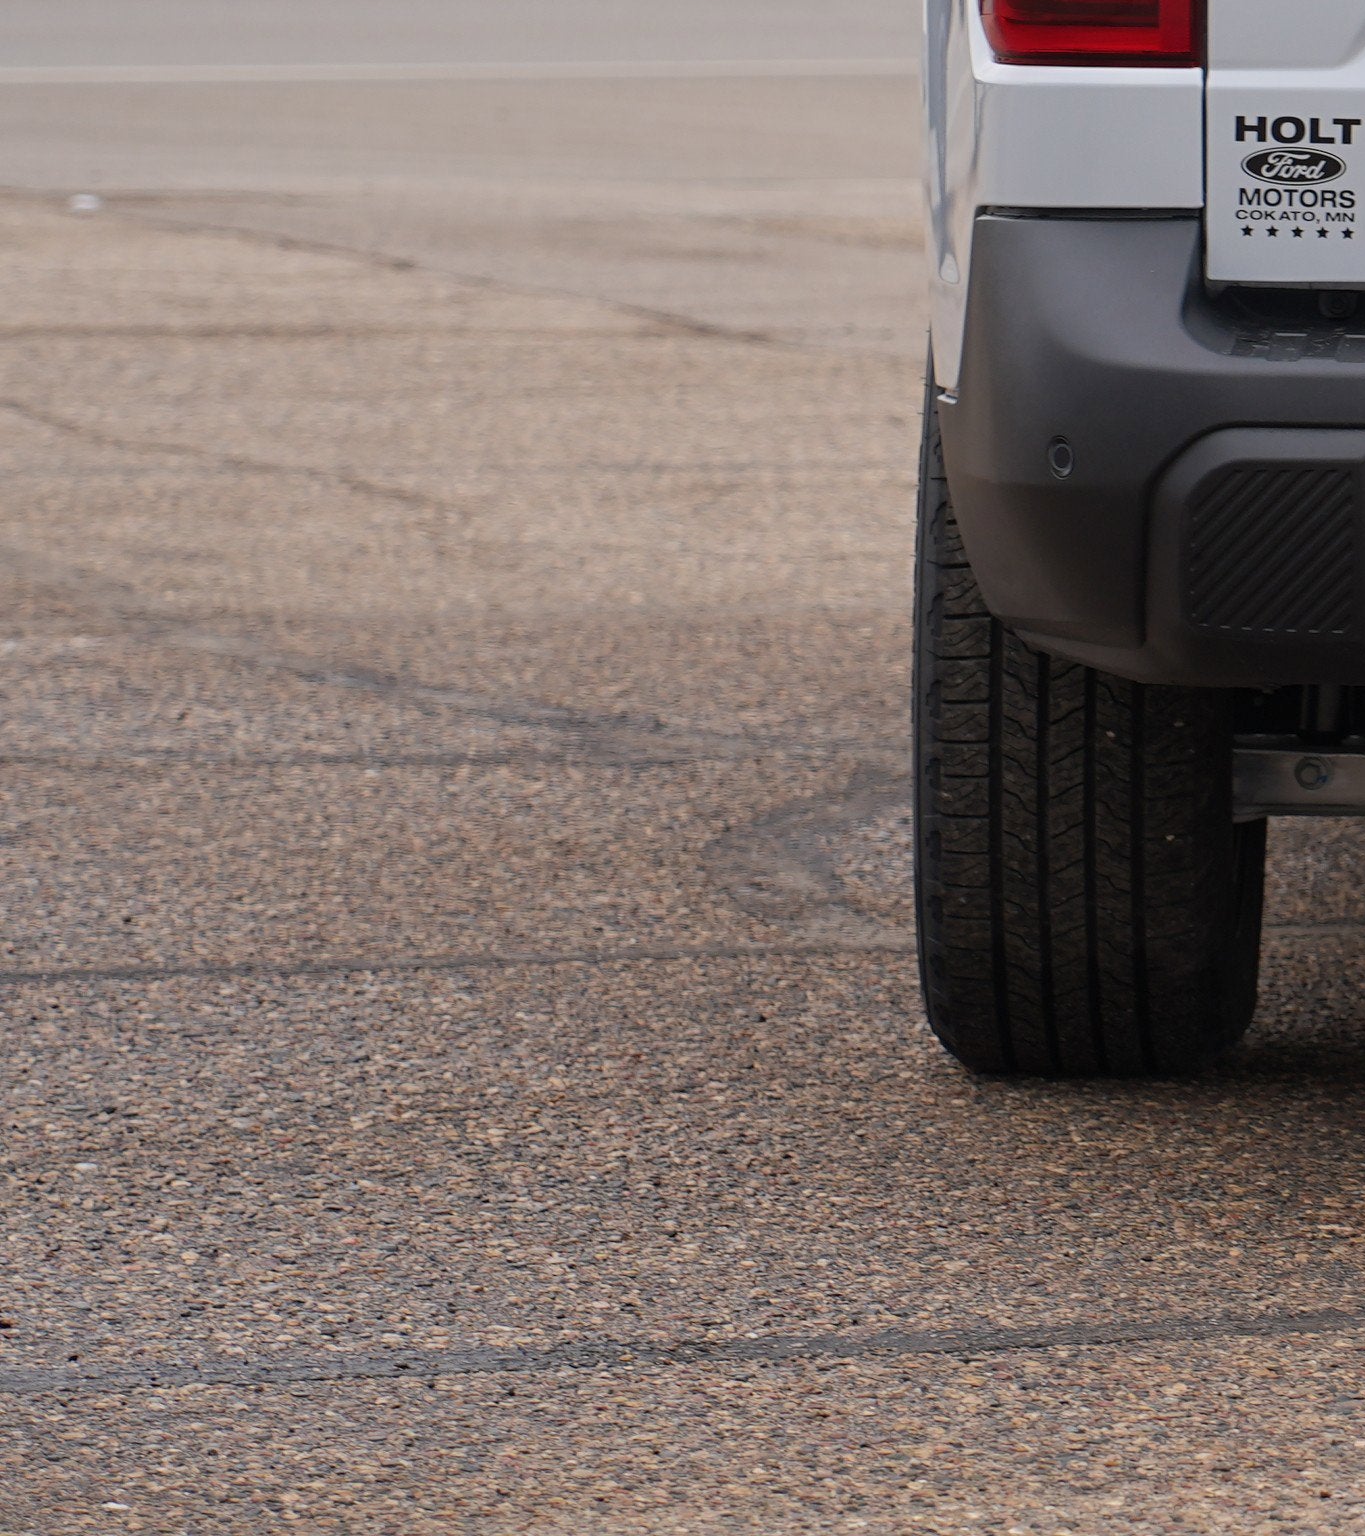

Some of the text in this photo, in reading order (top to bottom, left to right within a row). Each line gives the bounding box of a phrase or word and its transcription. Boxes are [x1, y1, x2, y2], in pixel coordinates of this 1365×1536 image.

[1235, 116, 1361, 144] HOLT
[1261, 152, 1326, 179] Ford
[1239, 188, 1355, 208] MOTORS
[1235, 210, 1355, 224] COKATO, MN
